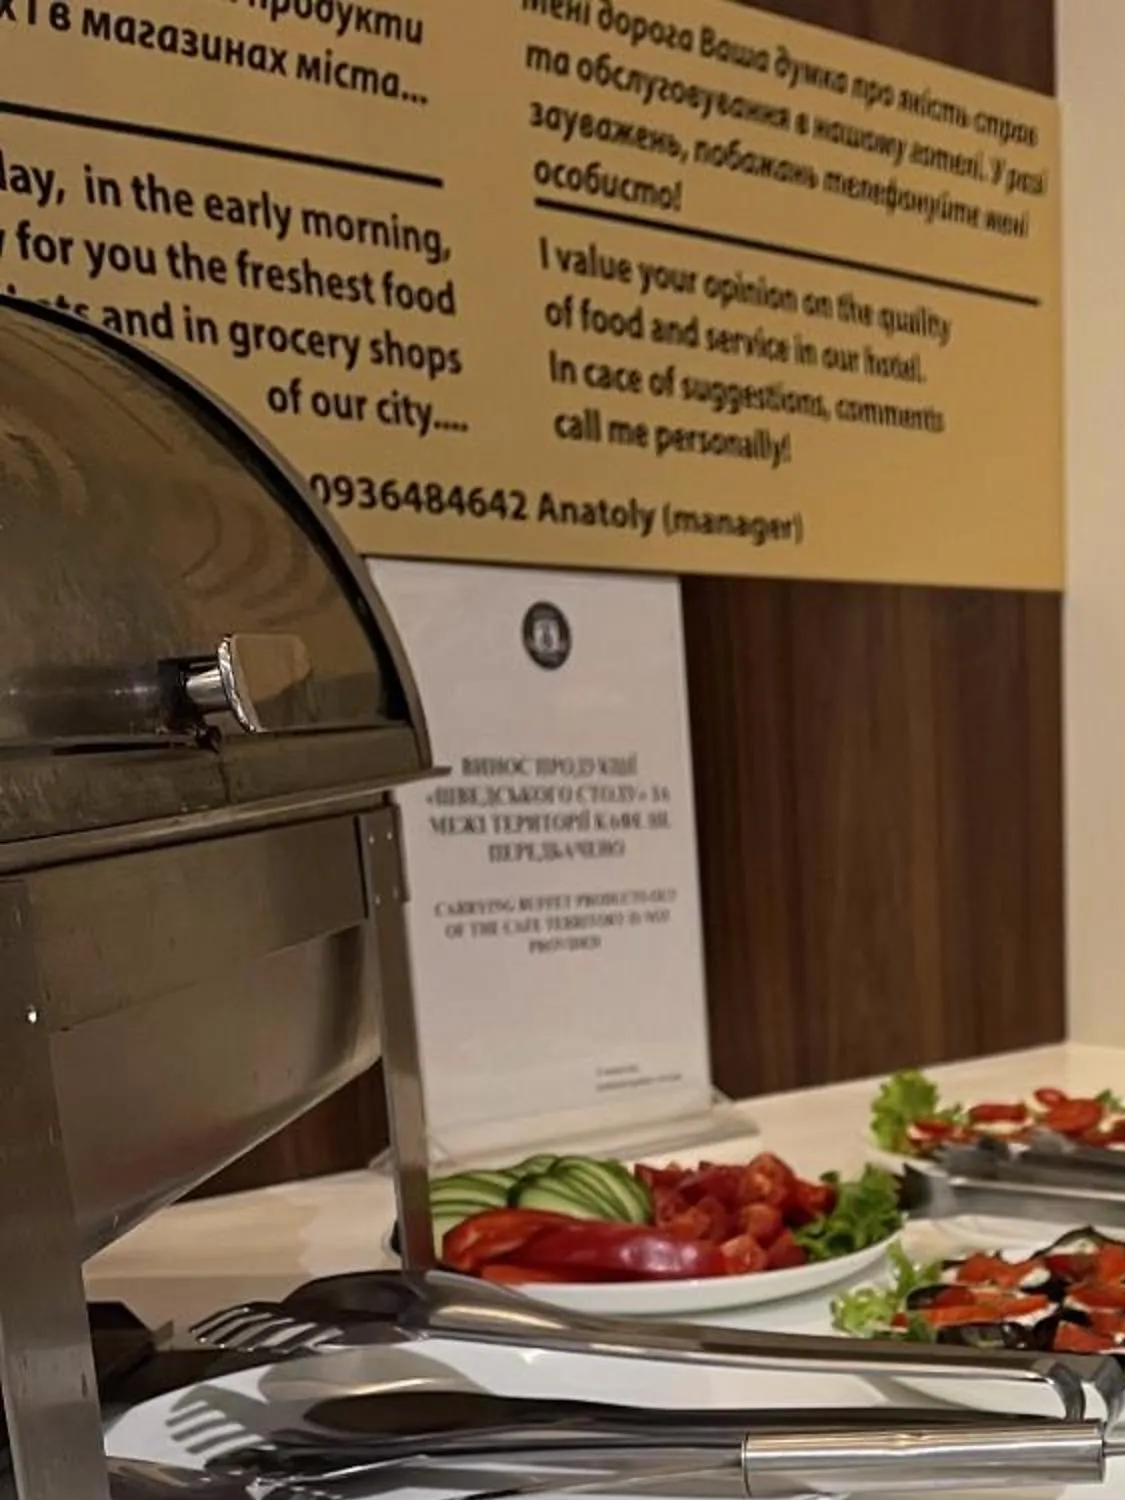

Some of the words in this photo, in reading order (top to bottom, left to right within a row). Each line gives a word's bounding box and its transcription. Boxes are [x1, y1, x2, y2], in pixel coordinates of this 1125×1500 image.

[50, 2, 71, 31] в
[82, 8, 288, 77] магазинах
[296, 48, 428, 105] міста...
[597, 1, 693, 52] дорога
[700, 26, 769, 73] Ваша
[774, 45, 848, 94] думка
[851, 77, 895, 110] про
[526, 45, 570, 76] та
[576, 52, 791, 131] обслуговування
[794, 112, 809, 135] в
[812, 117, 907, 168] нашому
[84, 163, 121, 208] in
[131, 172, 194, 218] the
[204, 190, 291, 241] early
[301, 213, 452, 265] morning,
[530, 102, 688, 164] зауважень,
[693, 139, 819, 189] побажань
[822, 171, 979, 228] телефонуйте
[984, 209, 1029, 238] мені
[534, 160, 682, 212] особисто!
[16, 219, 74, 266] for
[84, 239, 157, 280] you
[166, 241, 228, 286] the
[235, 249, 376, 305] freshest
[381, 270, 456, 317] food
[540, 236, 549, 269] I
[555, 243, 632, 284] value
[637, 261, 697, 296] your
[703, 270, 799, 313] opinion
[802, 293, 833, 319] on
[836, 290, 873, 327] the
[102, 301, 174, 340] and
[183, 305, 218, 345] in
[229, 320, 361, 372] grocery
[369, 329, 462, 380] shops
[545, 294, 573, 329] of
[580, 298, 643, 339] food
[651, 315, 698, 348] and
[705, 325, 789, 363] service
[794, 333, 818, 366] in
[821, 346, 859, 373] our
[863, 346, 927, 384] hotel.
[267, 377, 301, 414] of
[311, 390, 367, 421] our
[549, 349, 577, 383] In
[650, 365, 675, 396] of
[681, 376, 831, 422] suggestions,
[835, 397, 946, 433] comments
[554, 407, 602, 442] call
[608, 420, 648, 448] me
[655, 425, 791, 470] personally!
[310, 473, 527, 521] 0936484642
[537, 491, 655, 537] Anatoly
[661, 502, 803, 546] (manager)
